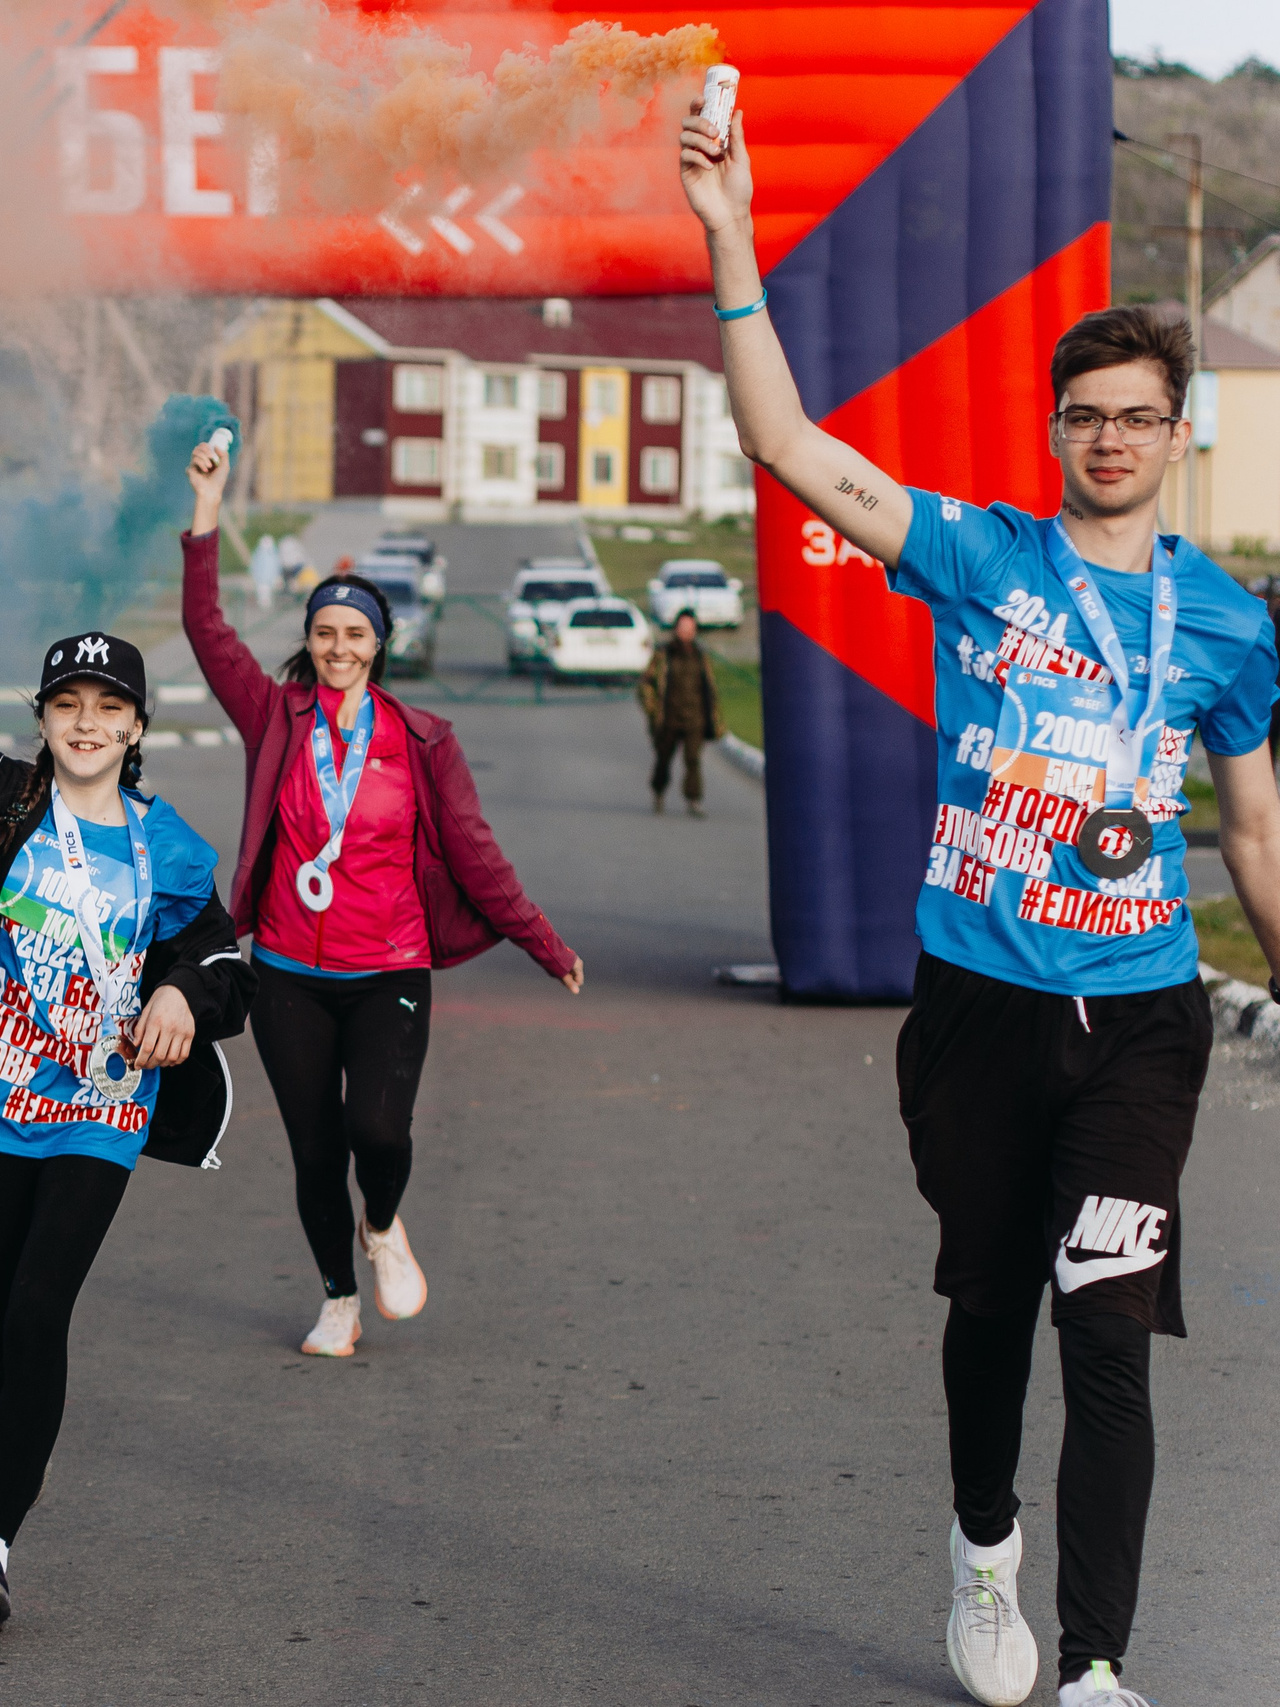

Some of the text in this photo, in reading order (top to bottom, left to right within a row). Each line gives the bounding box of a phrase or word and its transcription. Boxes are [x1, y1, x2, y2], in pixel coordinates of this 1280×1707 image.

[801, 520, 884, 568] ЗА
[993, 589, 1068, 642] 2024
[1032, 675, 1058, 689] ПСБ
[46, 837, 61, 851] ПС
[65, 831, 77, 854] ПСБ
[138, 856, 148, 880] ПСБ
[16, 925, 85, 974] 2024
[1066, 1195, 1168, 1258] NIKE
